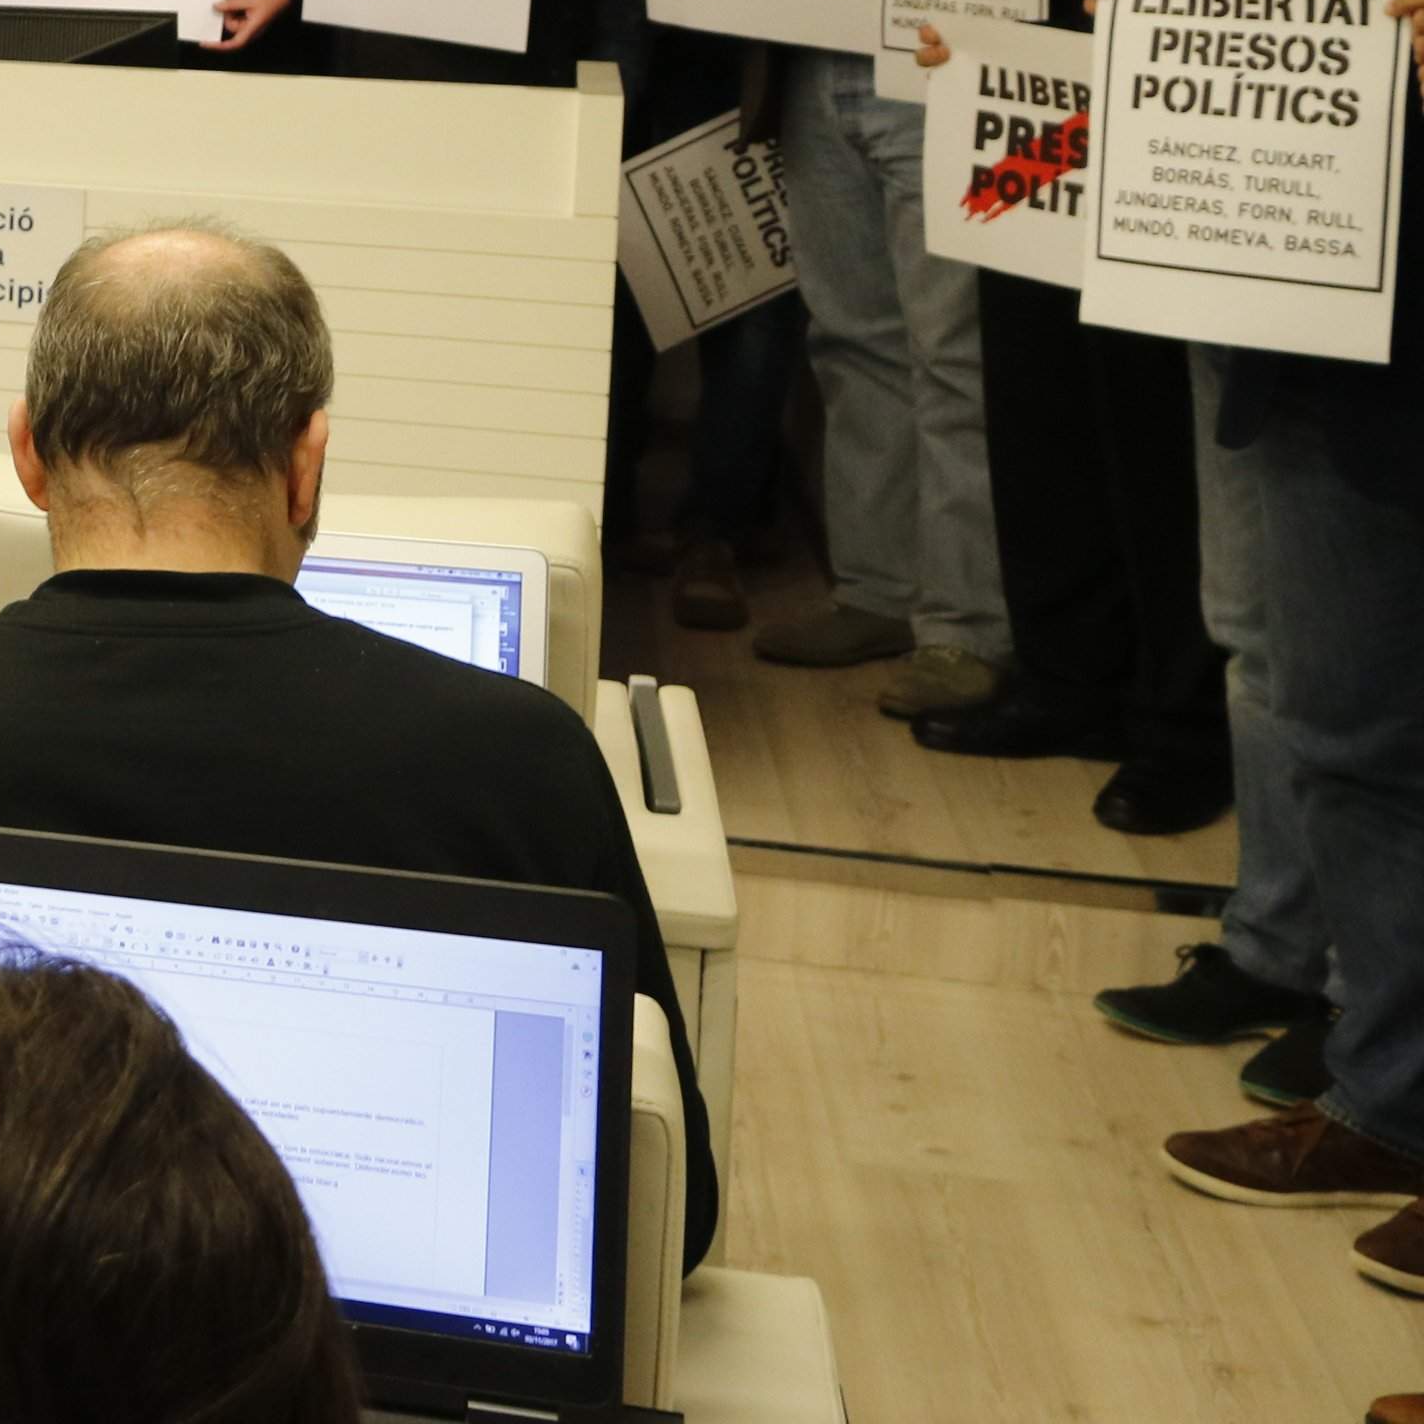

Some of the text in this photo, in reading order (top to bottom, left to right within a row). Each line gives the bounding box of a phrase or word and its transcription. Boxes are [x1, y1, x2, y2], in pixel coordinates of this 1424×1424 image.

[1149, 26, 1352, 78] PRESOS
[1130, 71, 1361, 129] POLÍTICS
[973, 109, 1089, 170] PRES
[1114, 188, 1364, 232] JUNQUERAS, FORN, RULL,
[1244, 174, 1321, 200] TURULL,
[1187, 224, 1274, 250] ROMEVA,
